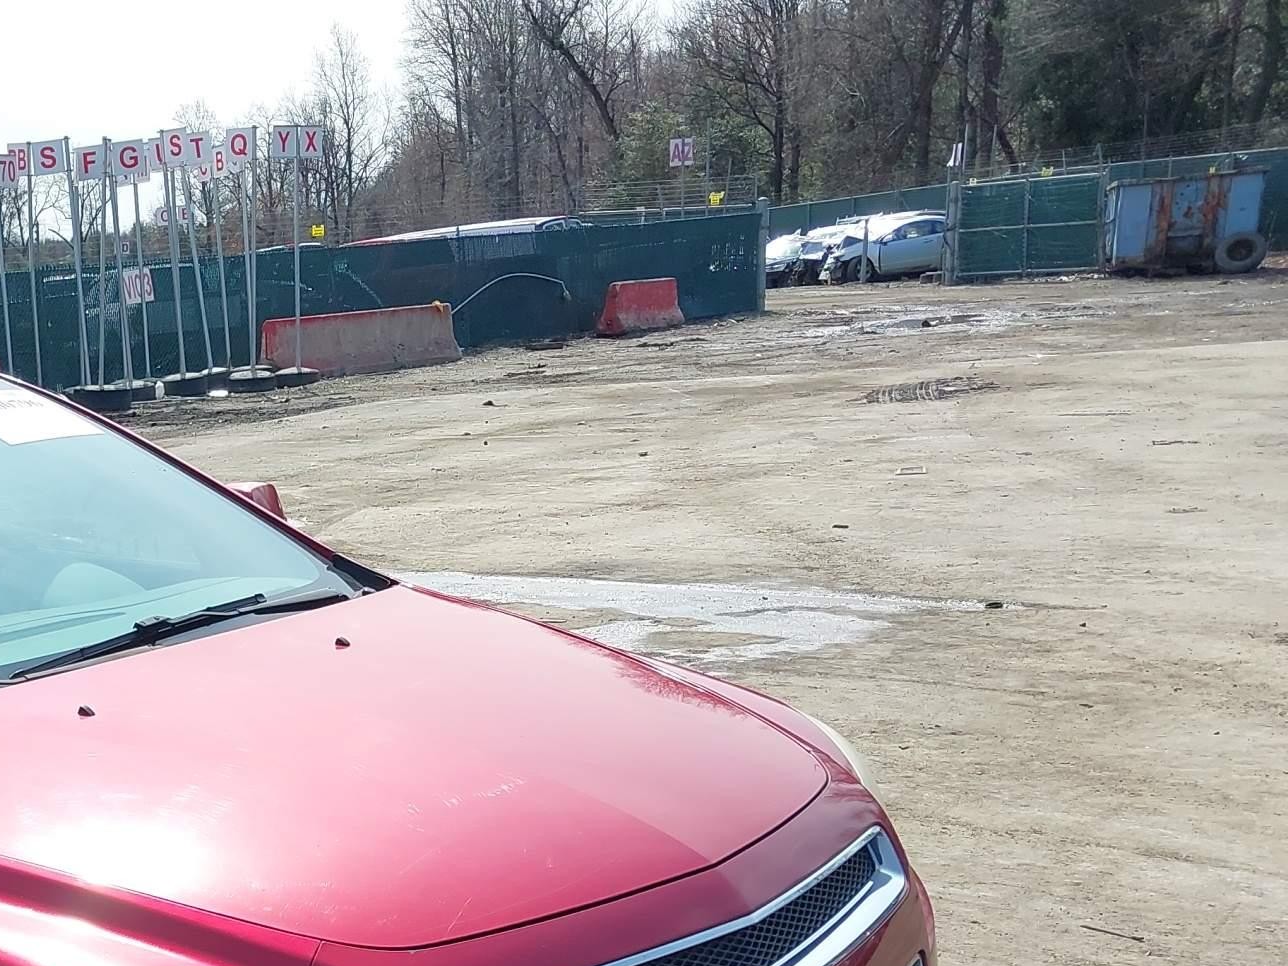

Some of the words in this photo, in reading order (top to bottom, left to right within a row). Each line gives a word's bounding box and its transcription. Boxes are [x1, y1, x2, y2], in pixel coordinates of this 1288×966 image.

[169, 134, 182, 156] S
[189, 138, 204, 158] T
[230, 133, 248, 156] Q
[278, 131, 290, 152] Y
[305, 131, 317, 152] X
[40, 146, 57, 169] S
[82, 151, 96, 174] F
[119, 146, 139, 169] G
[215, 151, 224, 171] B
[0, 160, 16, 182] 70
